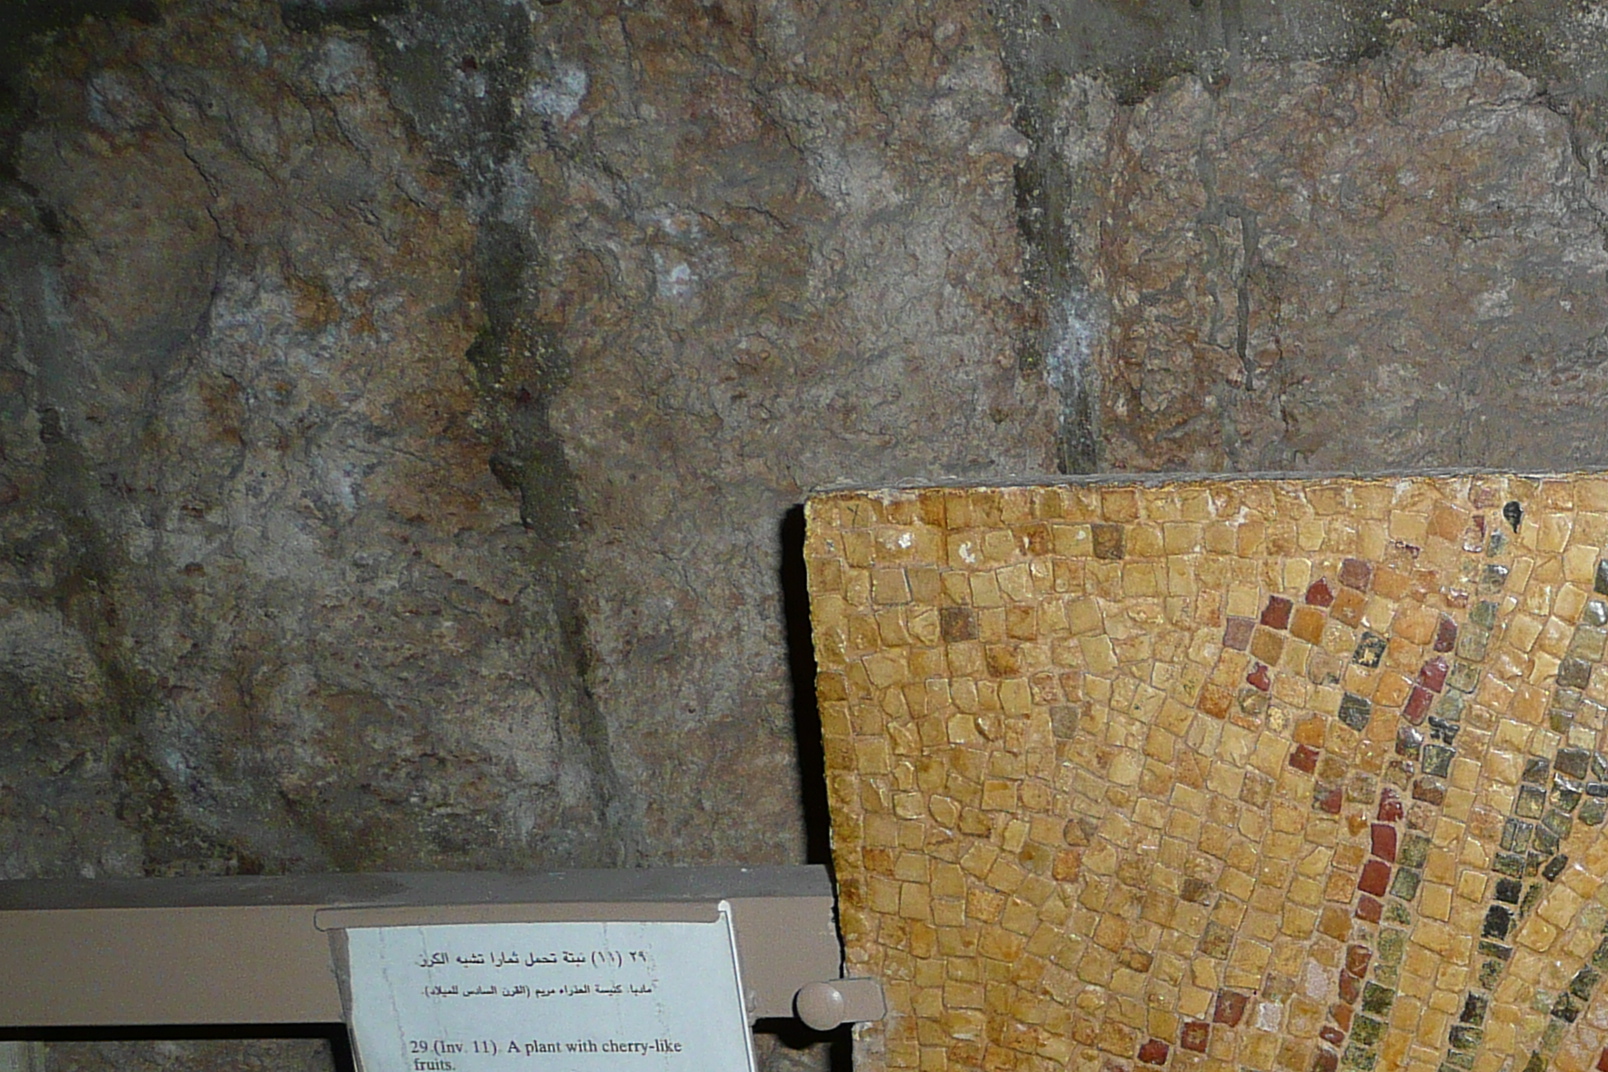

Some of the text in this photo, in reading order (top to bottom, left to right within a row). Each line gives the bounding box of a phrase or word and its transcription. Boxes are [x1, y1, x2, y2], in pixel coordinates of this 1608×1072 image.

[455, 952, 485, 969] تشبه
[490, 950, 520, 967] ثمارا
[524, 951, 557, 967] تحمل
[462, 984, 497, 997] السادس
[535, 984, 555, 998] مريم
[559, 983, 591, 996] العذراء
[594, 983, 623, 995] كنيسة
[507, 1040, 521, 1053] A
[525, 1039, 562, 1057] plant
[565, 1039, 598, 1053] with
[602, 1038, 682, 1057] cherry-like
[413, 1058, 457, 1071] fruits.
